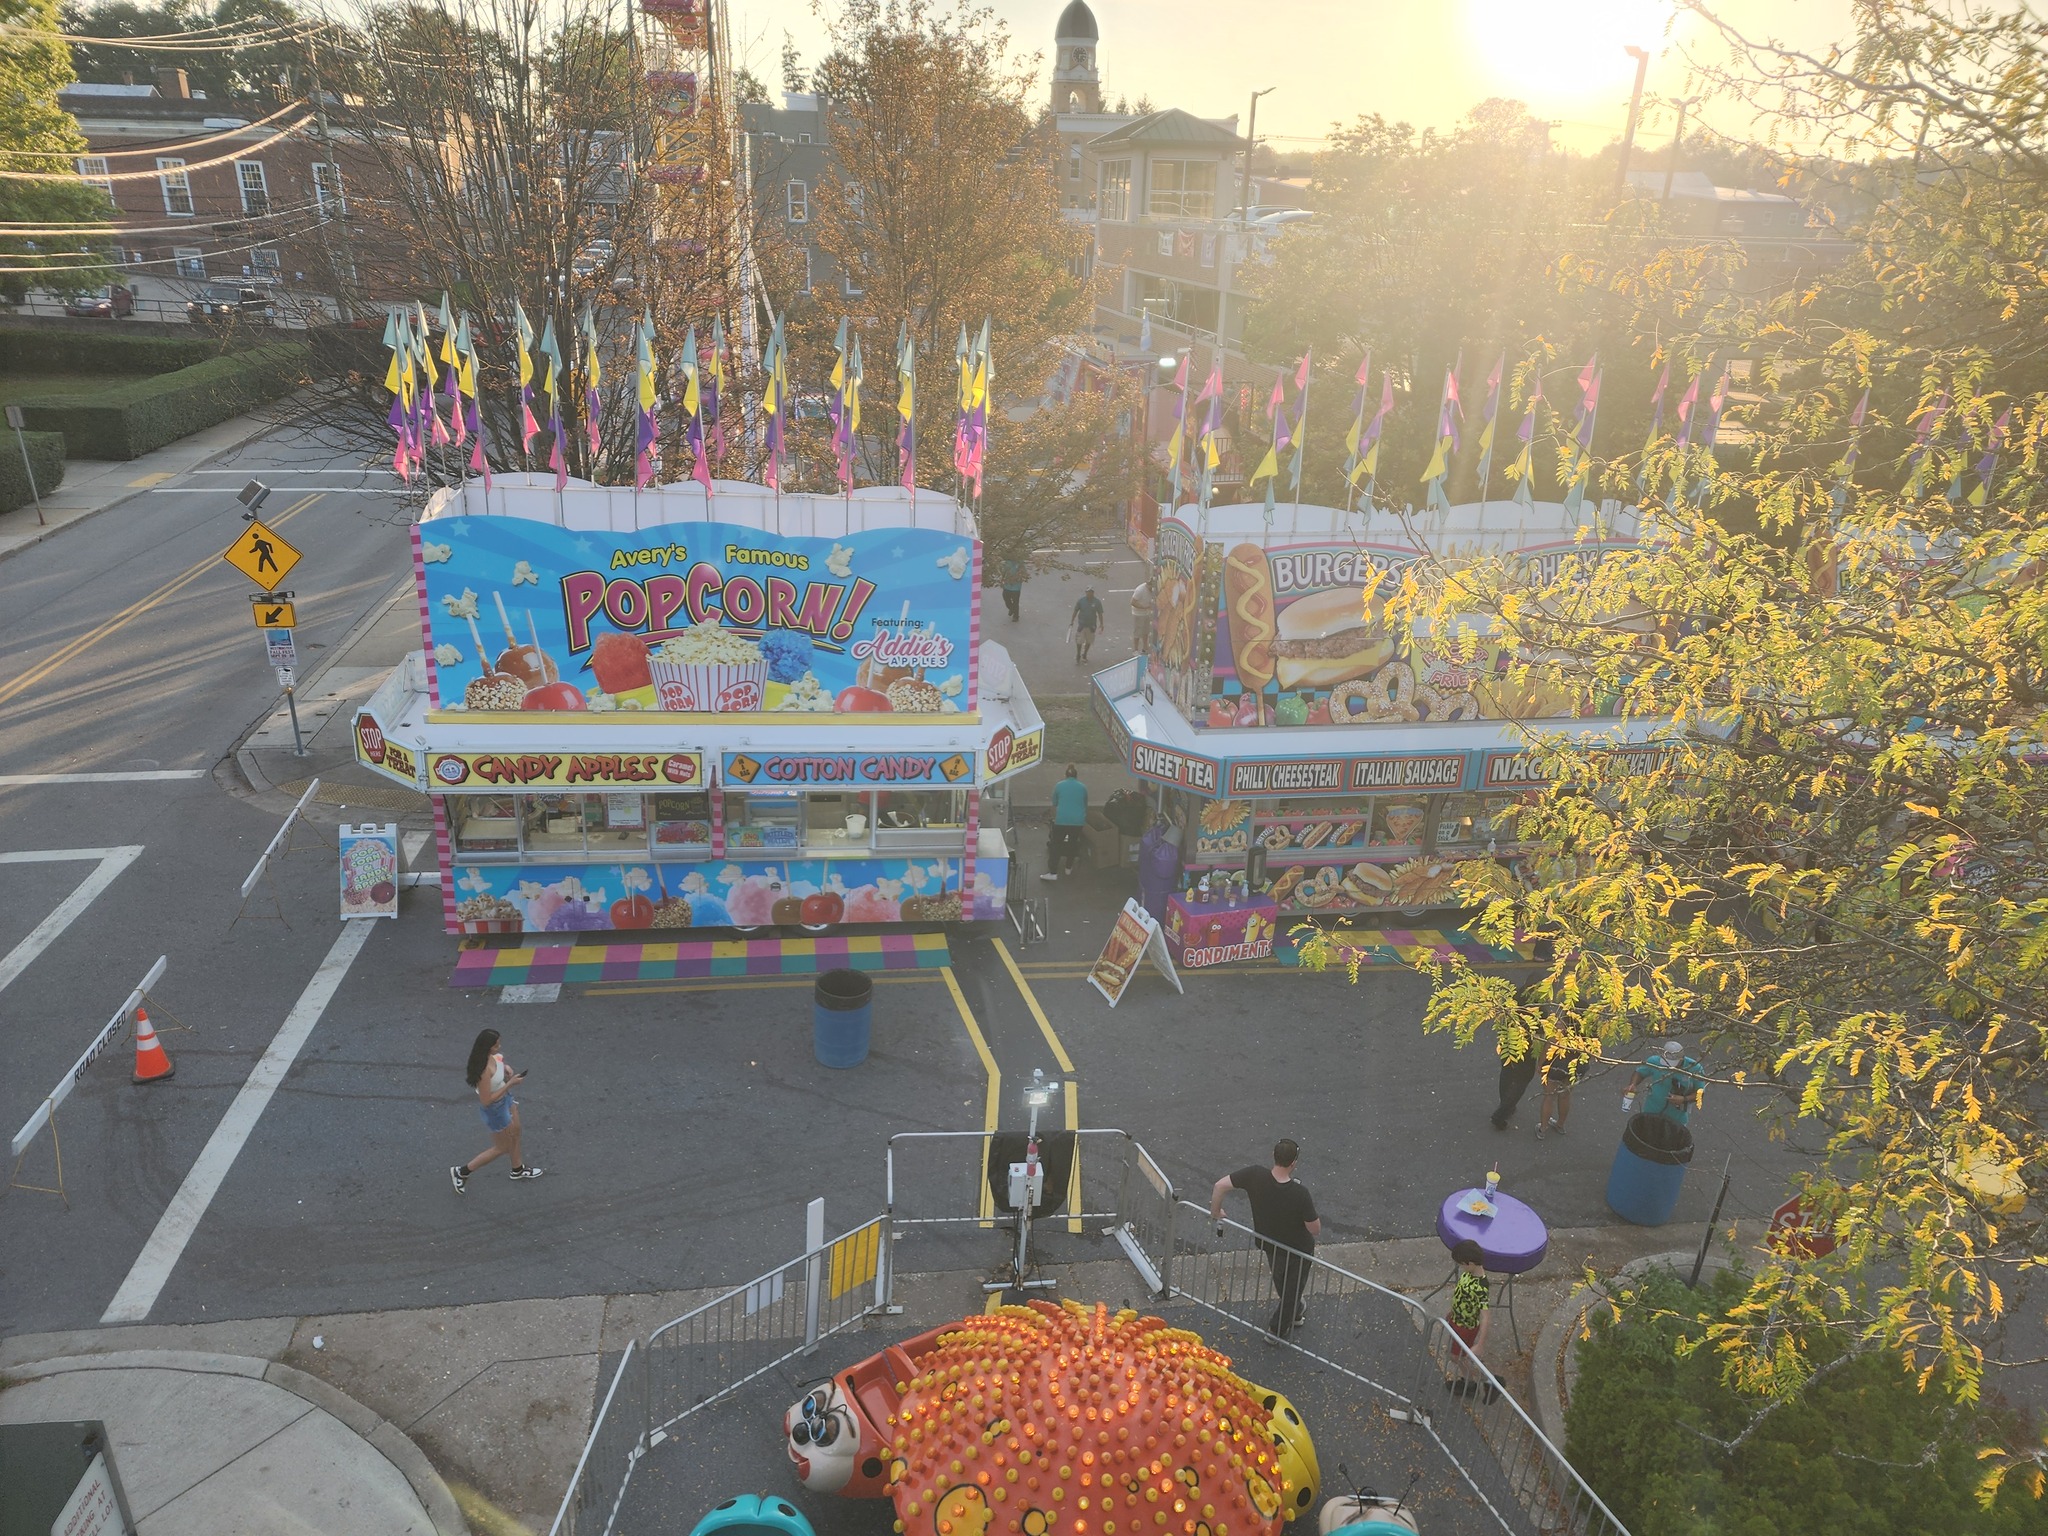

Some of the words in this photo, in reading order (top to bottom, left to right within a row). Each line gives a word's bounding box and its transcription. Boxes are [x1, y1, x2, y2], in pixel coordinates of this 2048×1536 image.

[610, 543, 687, 570] Avery's
[725, 544, 809, 571] Famous
[561, 562, 877, 652] POPCORN!
[871, 618, 924, 629] Featuring:
[852, 629, 952, 662] Addie's
[890, 657, 946, 666] APPLES
[661, 685, 683, 699] POP
[720, 685, 752, 703] POP
[361, 728, 382, 749] STOP
[1016, 740, 1027, 751] FOR
[389, 746, 403, 760] FOR
[404, 753, 409, 763] A
[989, 735, 1010, 766] STOP
[1011, 744, 1038, 765] TREAT
[386, 754, 416, 778] TREAT
[473, 754, 563, 784] CANDY
[566, 754, 659, 782] APPLES
[668, 759, 694, 771] Caramel
[679, 770, 691, 778] Nuts
[764, 755, 856, 781] COTTON
[859, 755, 936, 781] CANDY
[1135, 745, 1182, 780] SWEET
[1186, 757, 1214, 789] TEA
[1355, 762, 1403, 785] ITALIAN
[1404, 759, 1460, 784] SAUSAGE
[1235, 764, 1271, 790] PHILLY
[1271, 763, 1342, 788] CHEESESTEAK
[658, 798, 690, 811] POPCORN
[351, 847, 374, 860] POP
[351, 853, 381, 868] CORN
[353, 866, 389, 882] CANDY
[363, 864, 373, 872] &
[355, 872, 393, 891] APPLES
[1183, 939, 1273, 968] CONDIMENTS
[74, 1048, 95, 1083] ROAD
[97, 1010, 126, 1055] CLOSED
[64, 1479, 101, 1536] ADDITIONAL
[97, 1490, 107, 1508] AT
[101, 1499, 114, 1522] LOT
